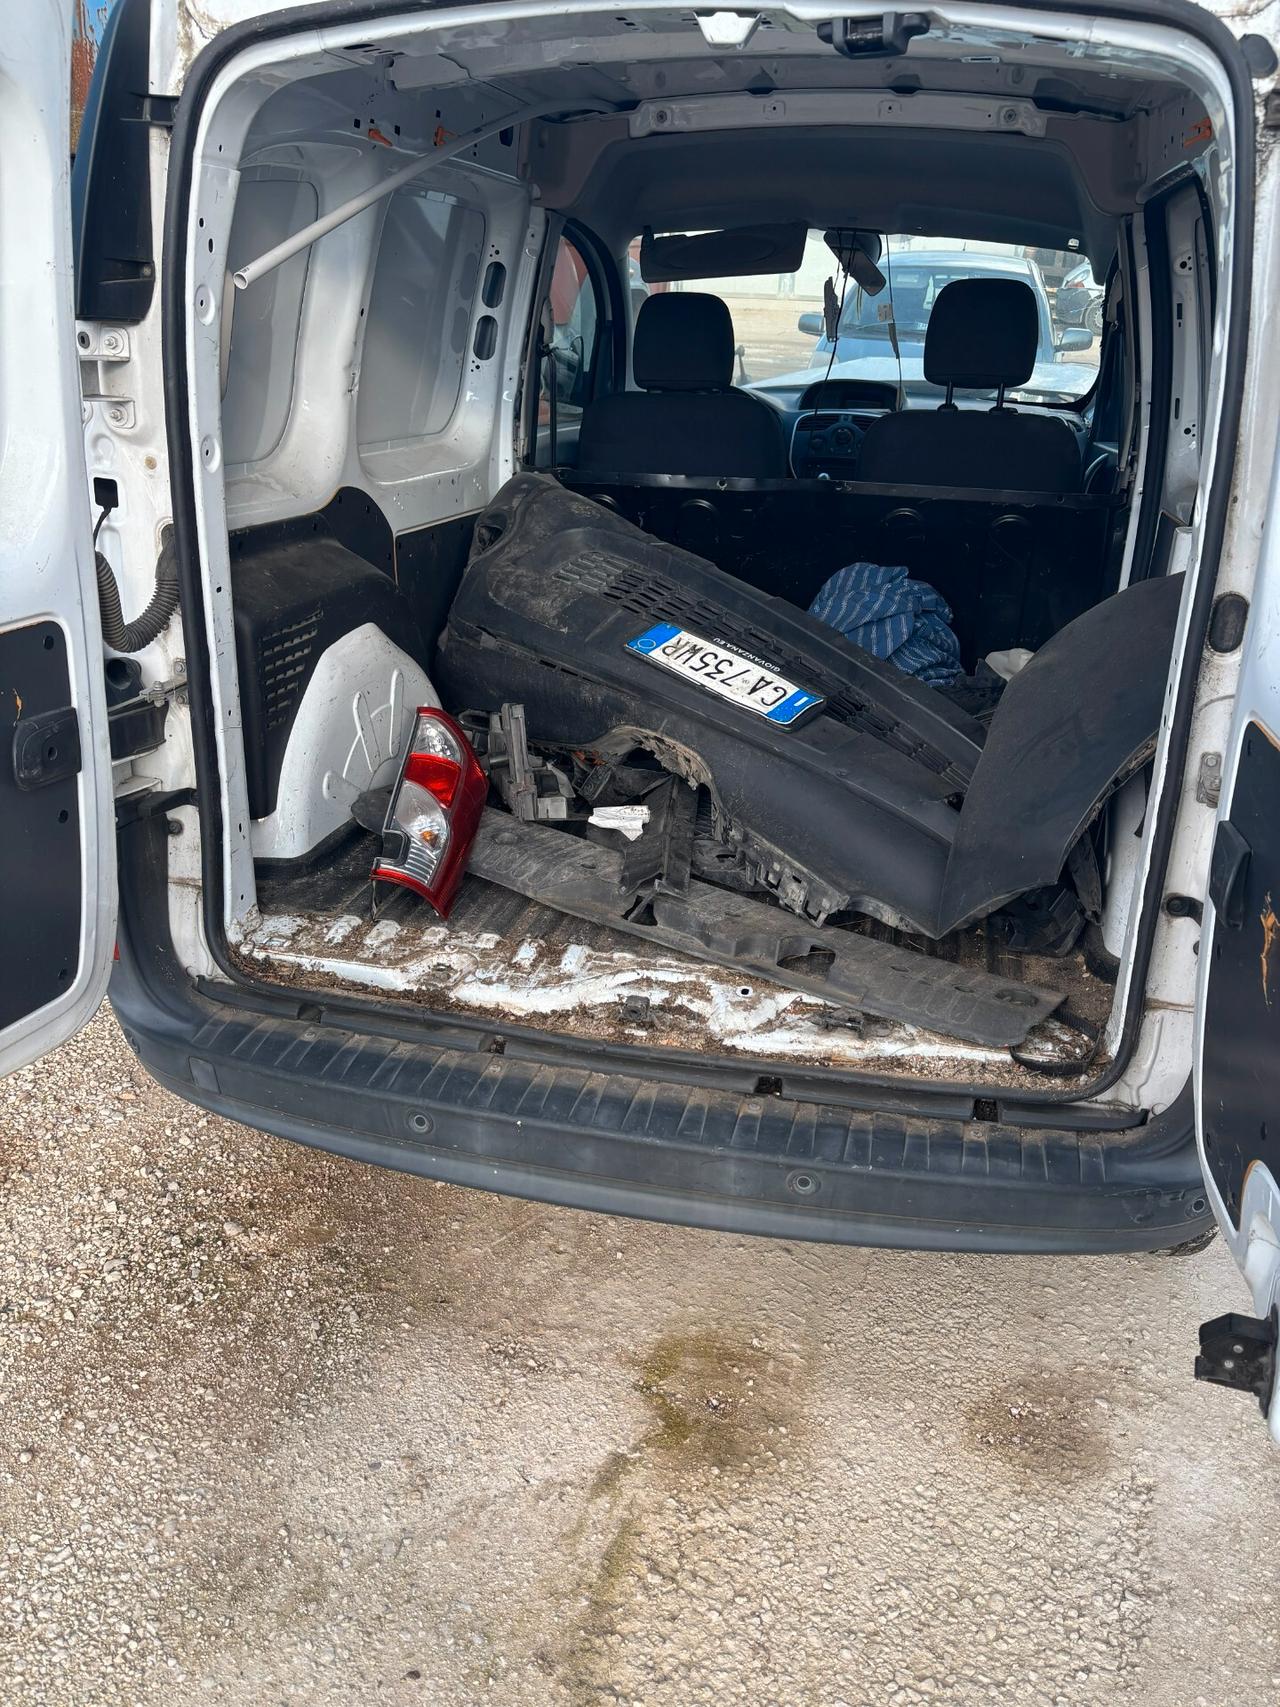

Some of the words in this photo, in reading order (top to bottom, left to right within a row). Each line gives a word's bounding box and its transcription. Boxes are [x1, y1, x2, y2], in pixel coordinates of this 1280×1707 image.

[661, 637, 751, 687] 735WR
[713, 637, 781, 672] GIOVANZANA.EU
[749, 675, 788, 707] GA
